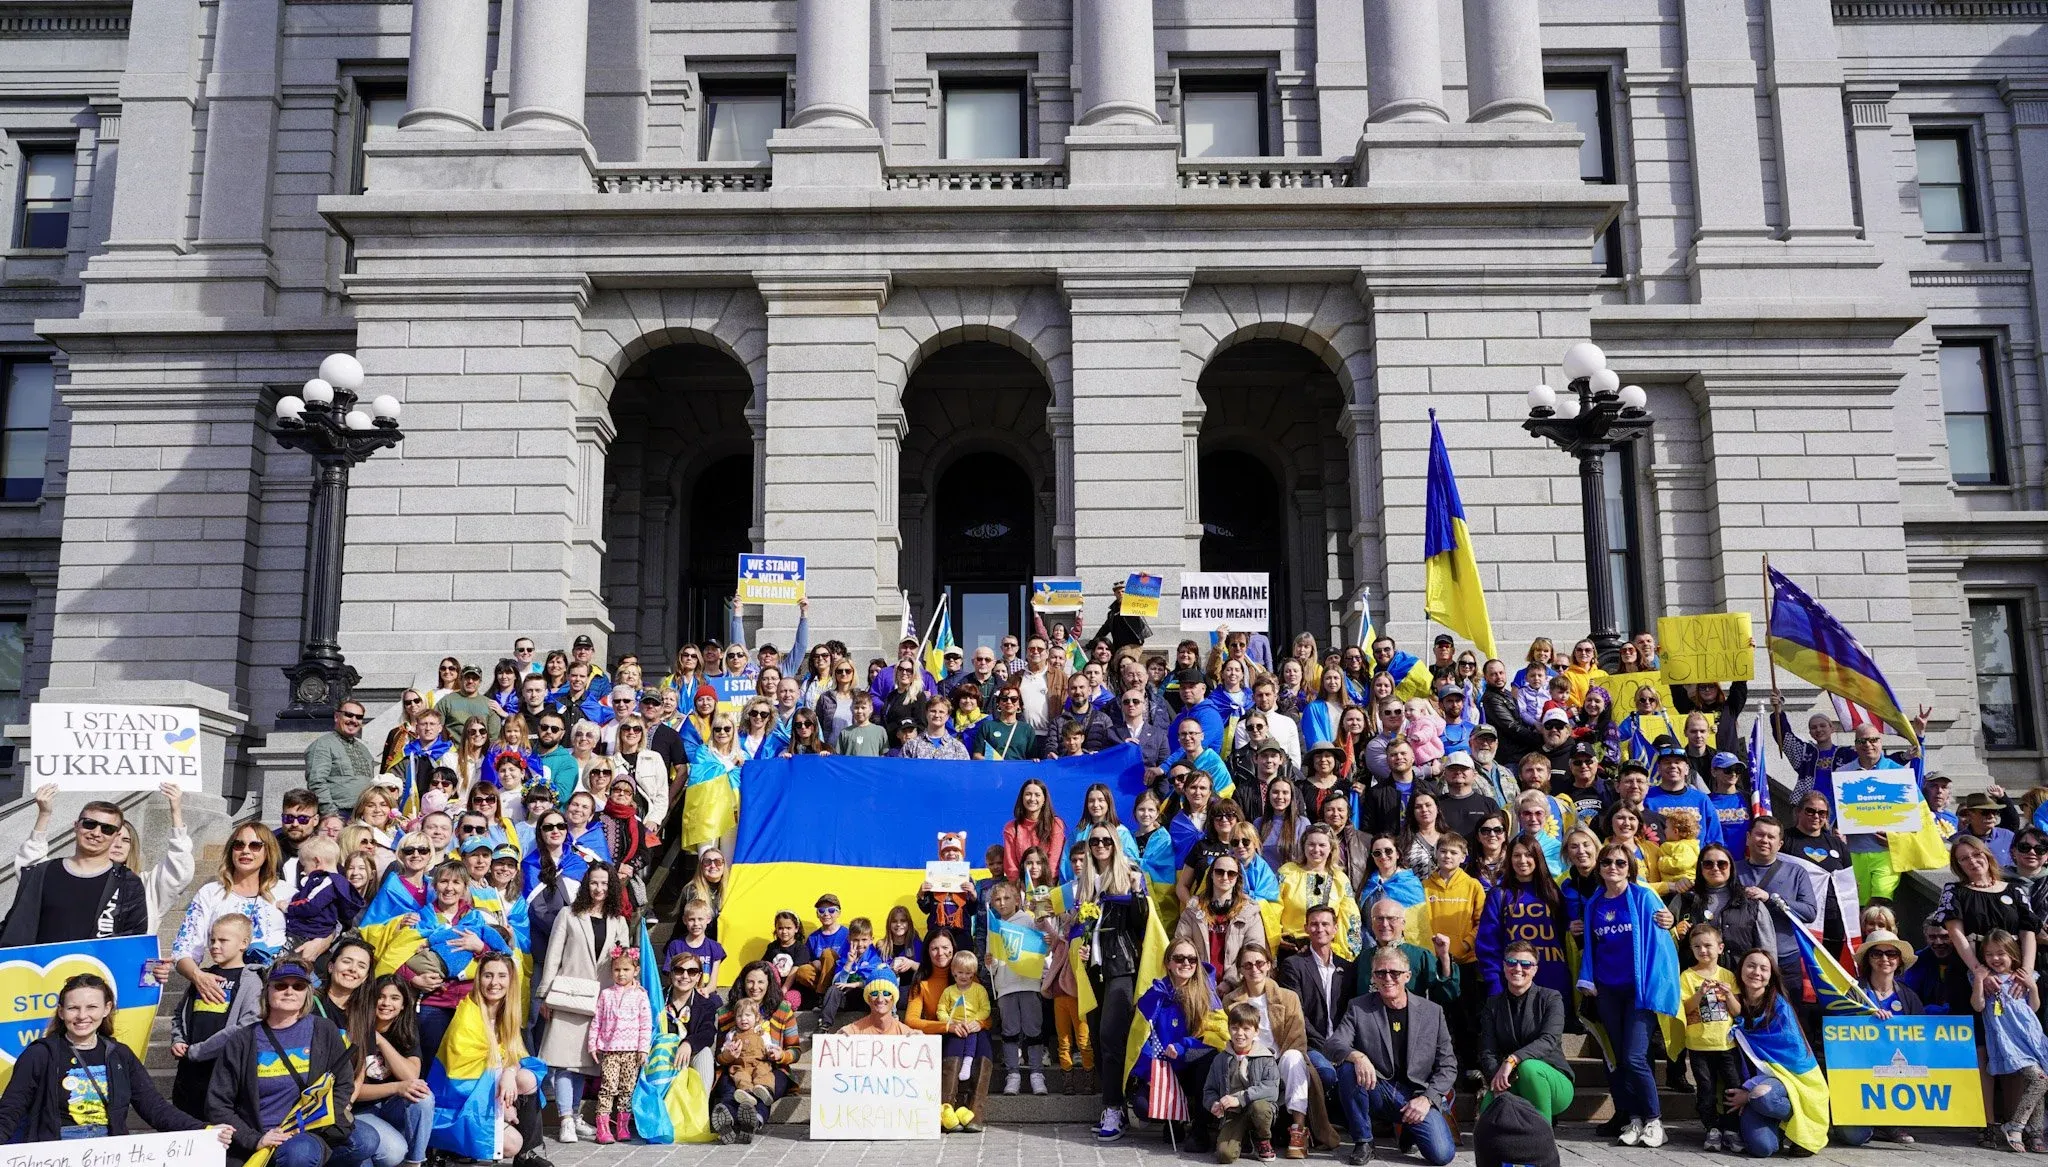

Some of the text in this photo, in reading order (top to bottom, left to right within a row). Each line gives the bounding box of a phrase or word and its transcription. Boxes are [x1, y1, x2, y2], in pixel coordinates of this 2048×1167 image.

[748, 559, 798, 572] WE STAND
[758, 572, 784, 584] WITH
[746, 585, 796, 599] UKRAINE
[1181, 586, 1268, 600] ARM UKRAINE
[1182, 608, 1267, 618] LIKE YOU MEAN IT!
[1660, 617, 1750, 654] UKRAINE
[1668, 651, 1748, 681] STRONG
[724, 680, 756, 692] I STA
[64, 712, 178, 732] I STAND
[73, 732, 152, 750] WITH
[34, 754, 197, 776] UKRAINE
[1506, 924, 1554, 940] YOU
[1538, 946, 1565, 962] TIN
[14, 992, 59, 1012] STO
[1824, 1025, 1972, 1042] SEND THE AID
[818, 1039, 934, 1070] AMERICA
[832, 1073, 918, 1098] STANDS
[1860, 1084, 1952, 1111] NOW
[820, 1103, 934, 1135] UKRAINE
[128, 1144, 156, 1163] the
